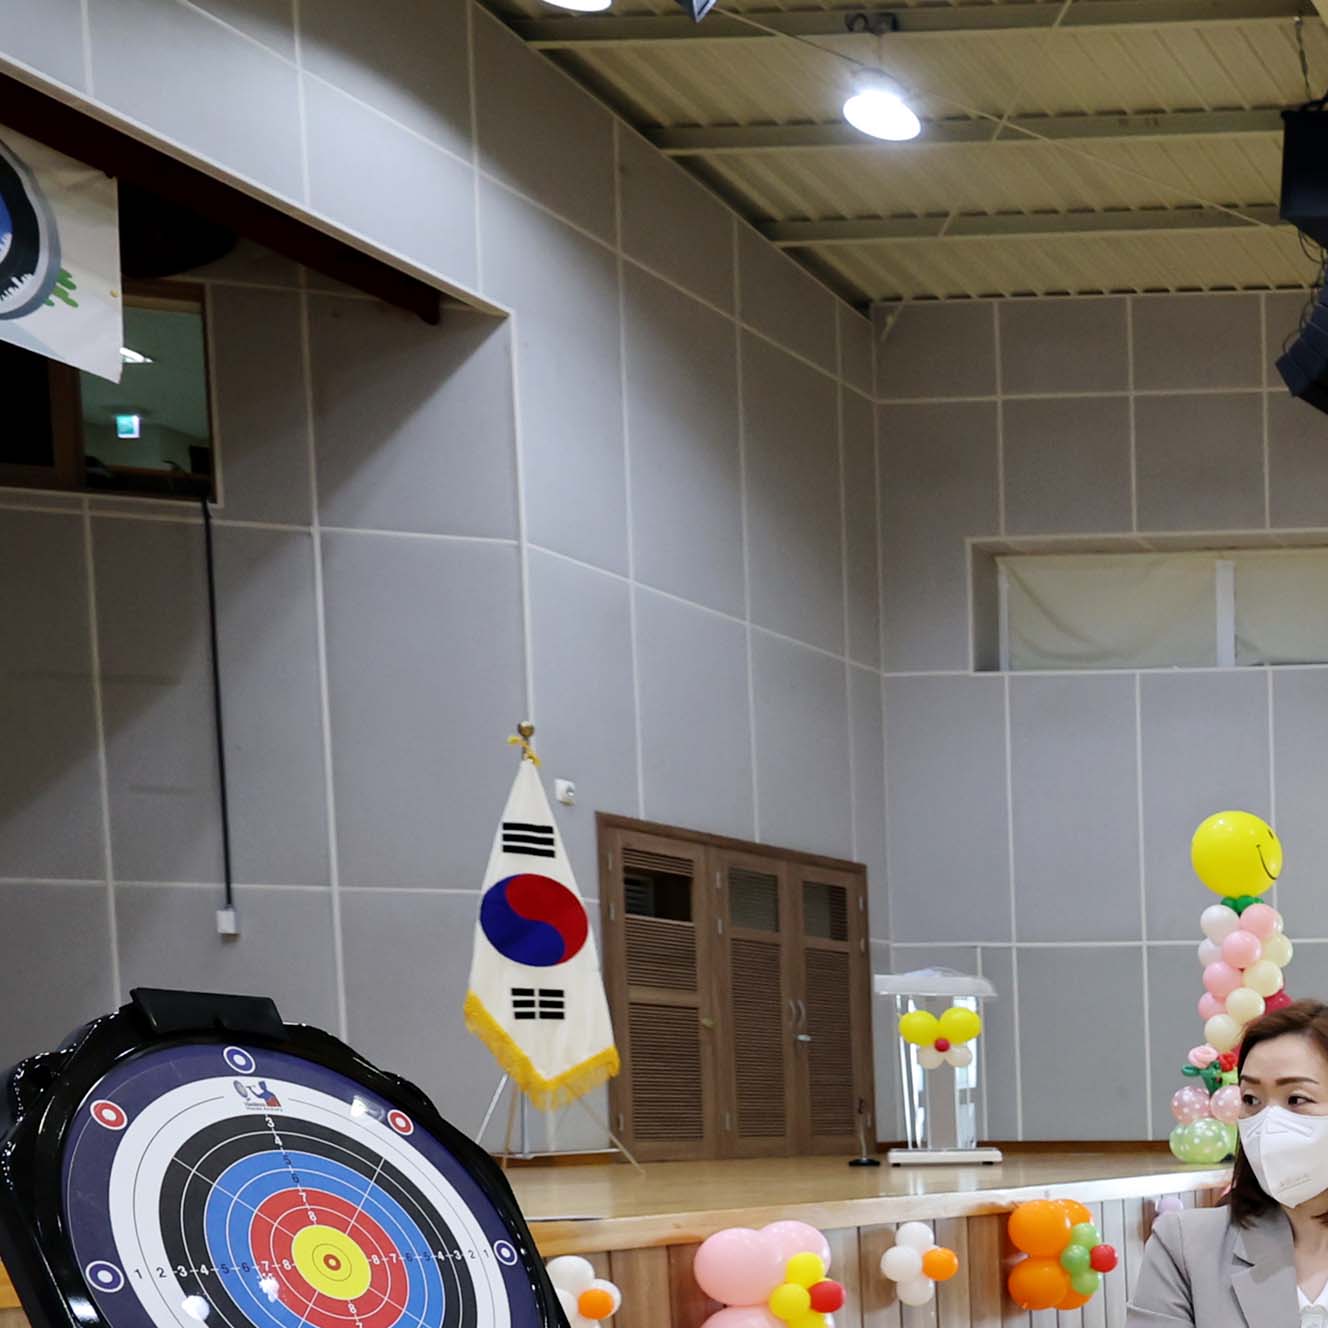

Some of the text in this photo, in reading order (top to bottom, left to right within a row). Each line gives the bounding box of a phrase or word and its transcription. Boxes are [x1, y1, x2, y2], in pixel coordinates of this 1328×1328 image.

[265, 1117, 317, 1222] 3 4 5 6 7 8
[371, 1249, 489, 1265] 8 7 6 5 4 3 2 1
[134, 1259, 292, 1279] 1 2 3 4 5 6 7 8
[348, 1303, 357, 1314] 8
